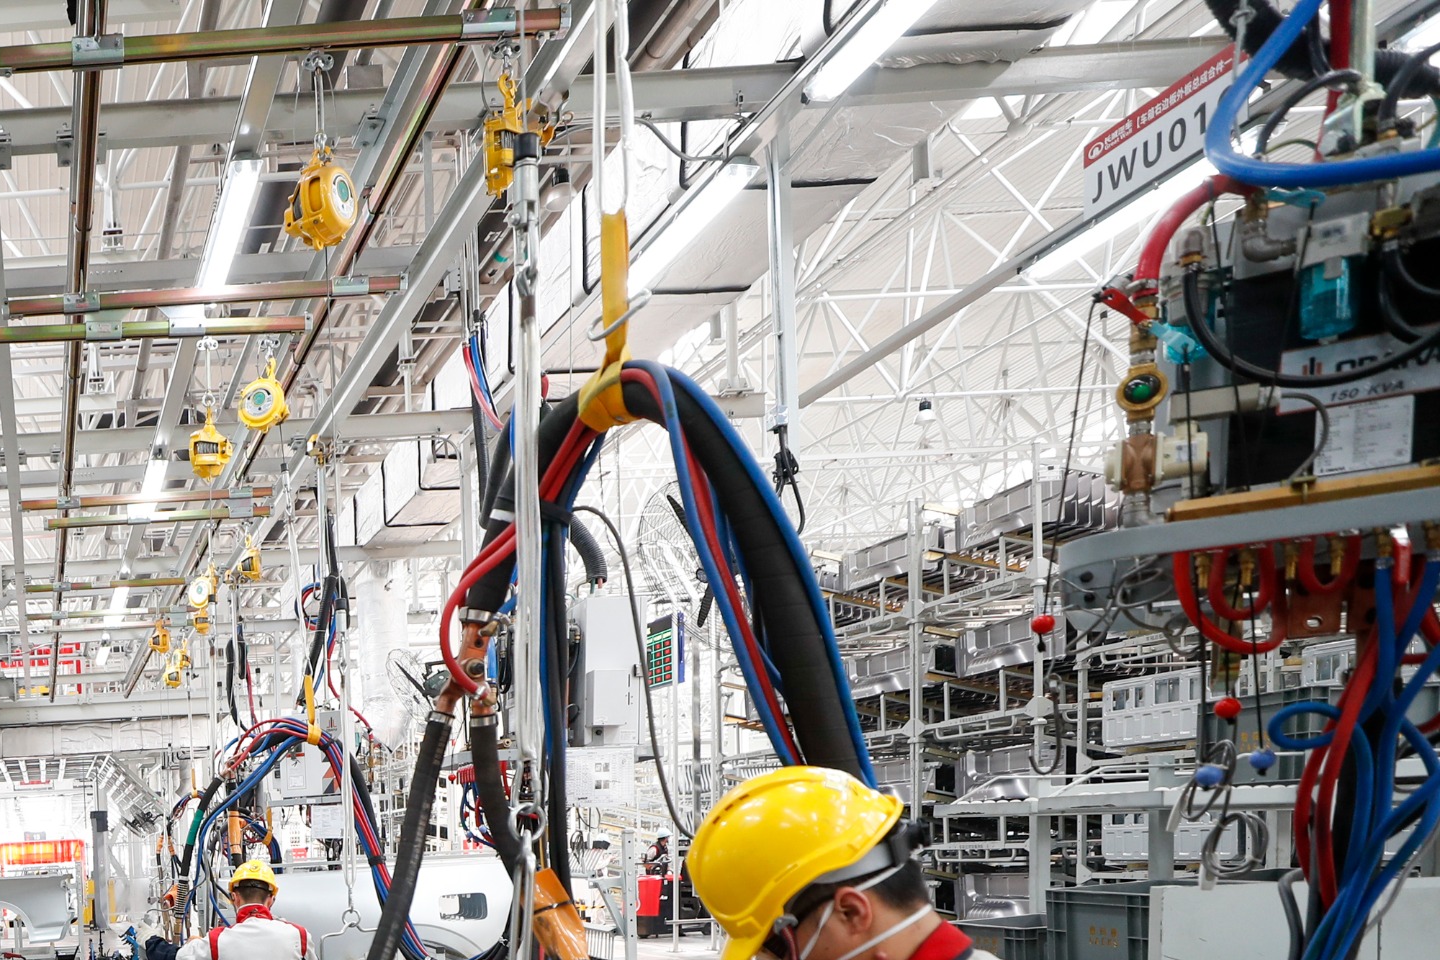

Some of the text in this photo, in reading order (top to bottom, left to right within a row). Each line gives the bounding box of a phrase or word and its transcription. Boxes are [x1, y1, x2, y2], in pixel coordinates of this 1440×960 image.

[1091, 84, 1232, 204] JWU01
[1331, 380, 1404, 401] 150 KVA
